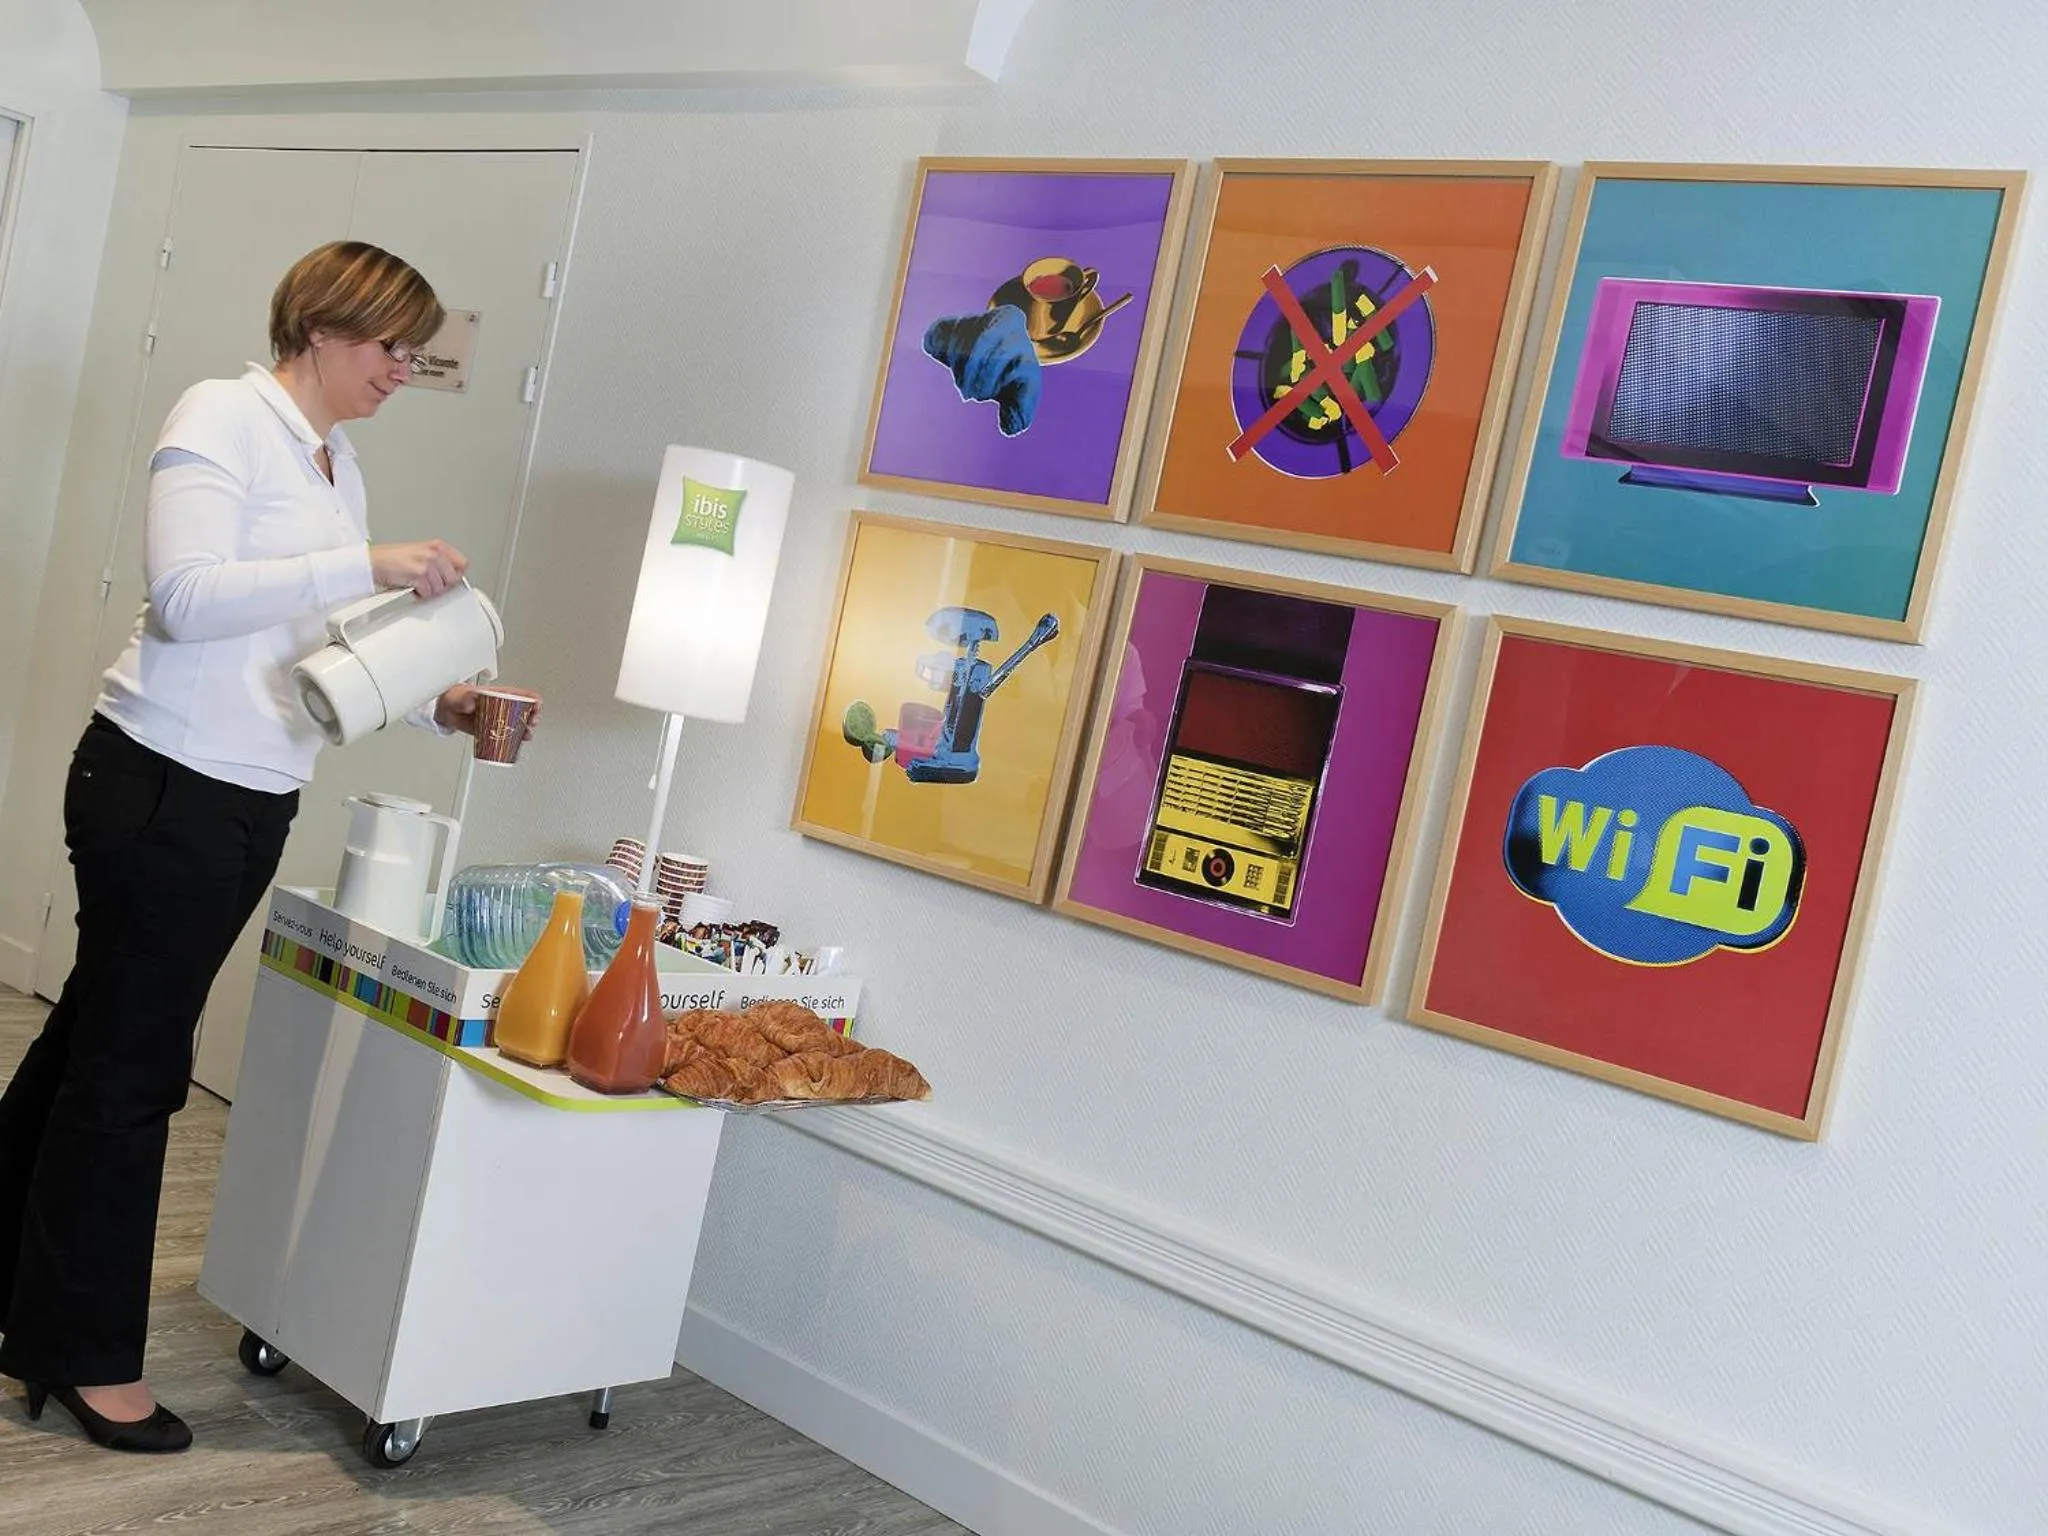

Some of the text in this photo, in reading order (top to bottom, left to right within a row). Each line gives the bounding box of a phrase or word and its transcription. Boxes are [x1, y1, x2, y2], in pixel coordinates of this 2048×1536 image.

[693, 494, 728, 519] ibis
[1538, 794, 1770, 912] Wi Fi
[320, 928, 342, 952] Help
[343, 941, 386, 970] yourself
[391, 964, 427, 990] Bedienen
[427, 981, 440, 997] Sie
[440, 988, 457, 1004] sich
[659, 990, 726, 1010] ourself
[800, 995, 819, 1010] Sie
[821, 995, 845, 1010] sich
